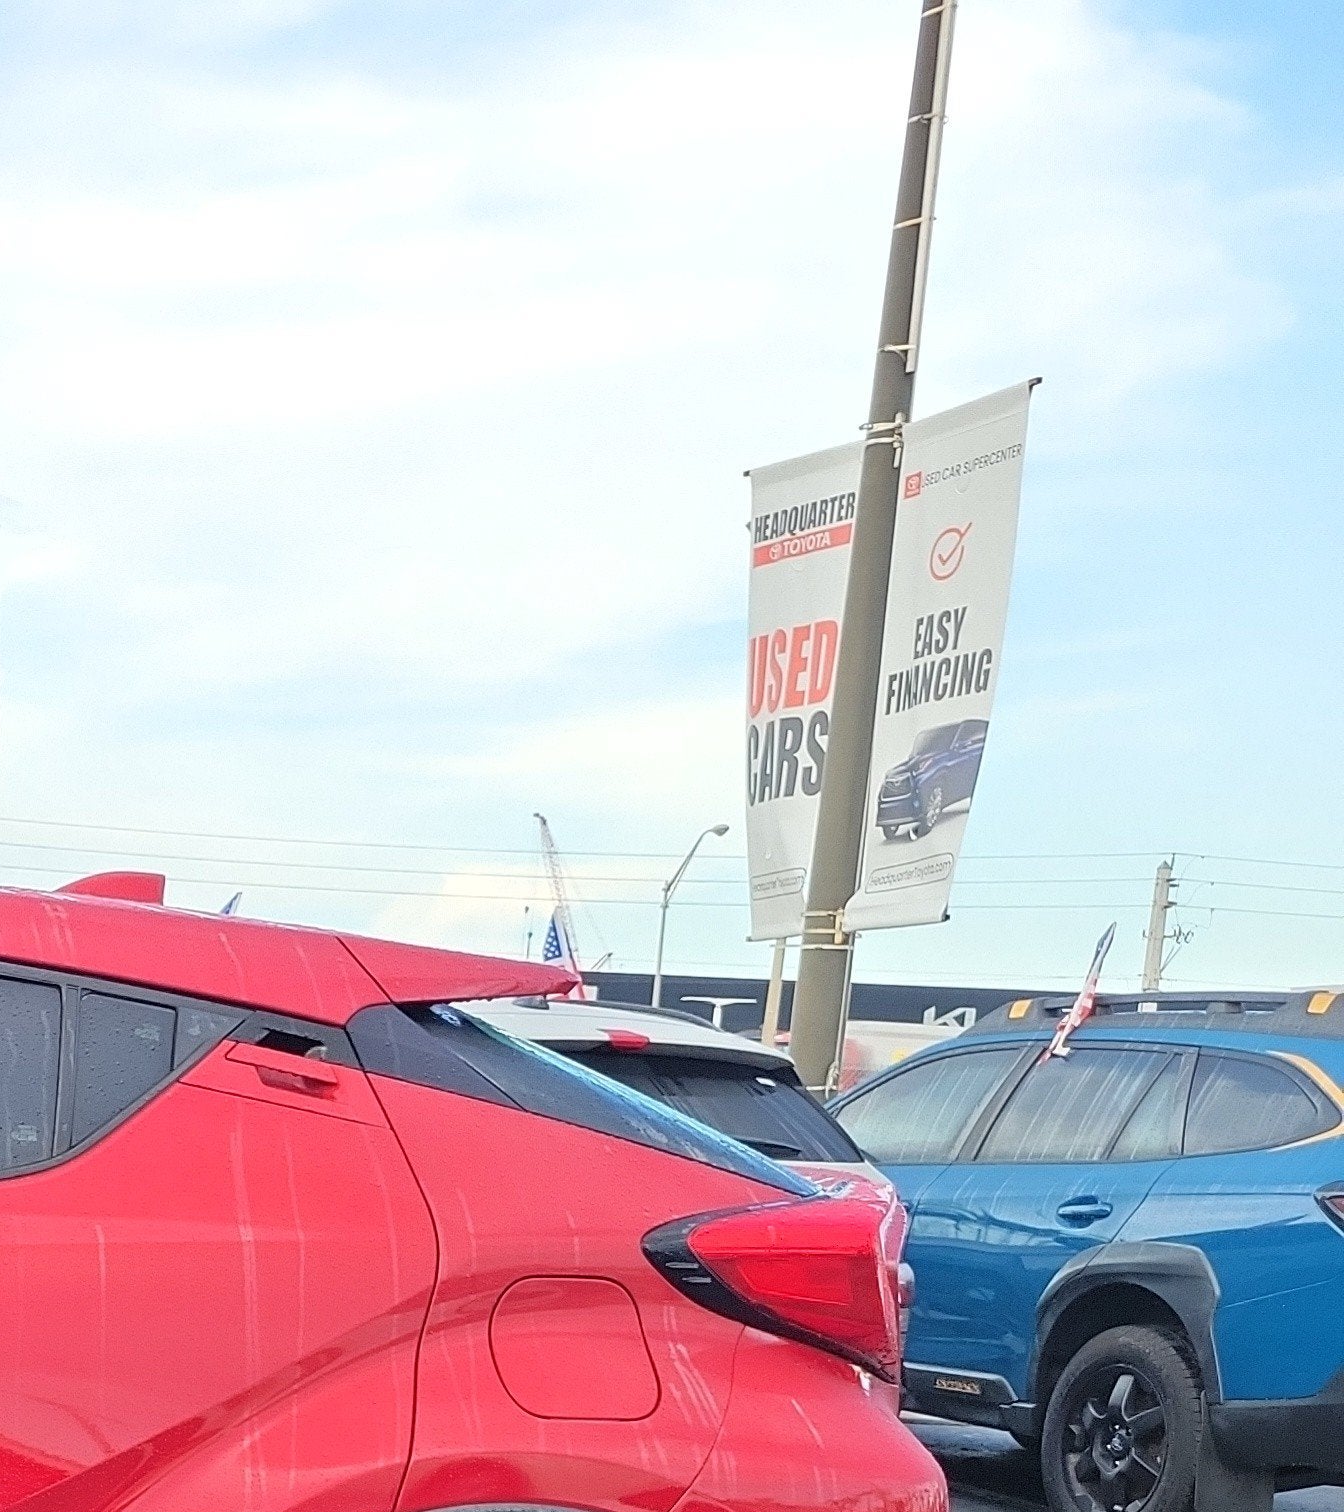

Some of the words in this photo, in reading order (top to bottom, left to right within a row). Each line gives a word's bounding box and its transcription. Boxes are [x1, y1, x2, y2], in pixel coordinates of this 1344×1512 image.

[942, 464, 962, 480] CAR
[754, 492, 856, 544] HEADQUARTER
[782, 531, 832, 556] TOYOTA
[913, 606, 968, 660] EASY
[748, 619, 839, 719] USED
[748, 710, 829, 807] CARS
[923, 1005, 977, 1032] KI
